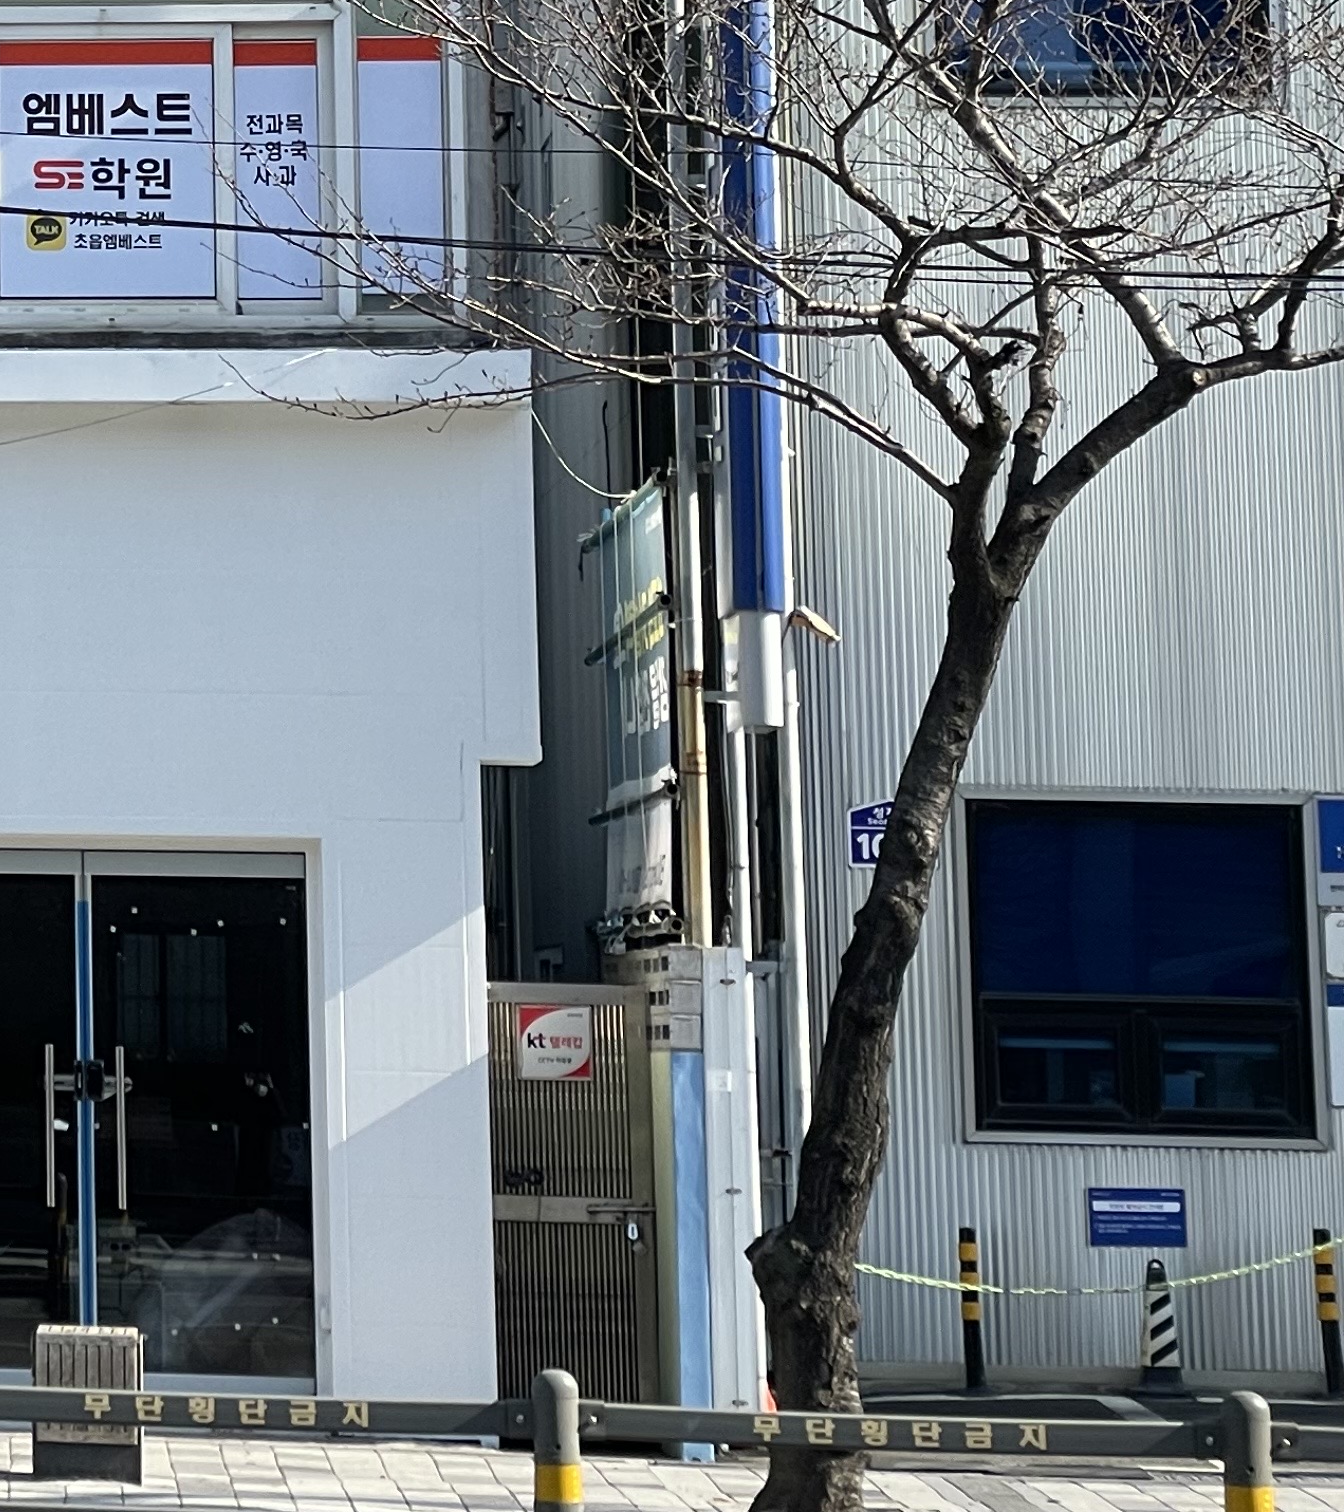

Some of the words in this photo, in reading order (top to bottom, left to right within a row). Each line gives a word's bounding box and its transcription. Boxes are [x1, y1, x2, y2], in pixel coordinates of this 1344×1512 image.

[22, 92, 193, 136] 엠베스트
[246, 113, 304, 135] 전과목
[240, 139, 308, 163] 수·영·국
[91, 157, 172, 201] 학원
[527, 1032, 547, 1049] kt
[82, 1391, 372, 1430] 무단횡단금지
[752, 1415, 1050, 1453] 무단횡단금지
